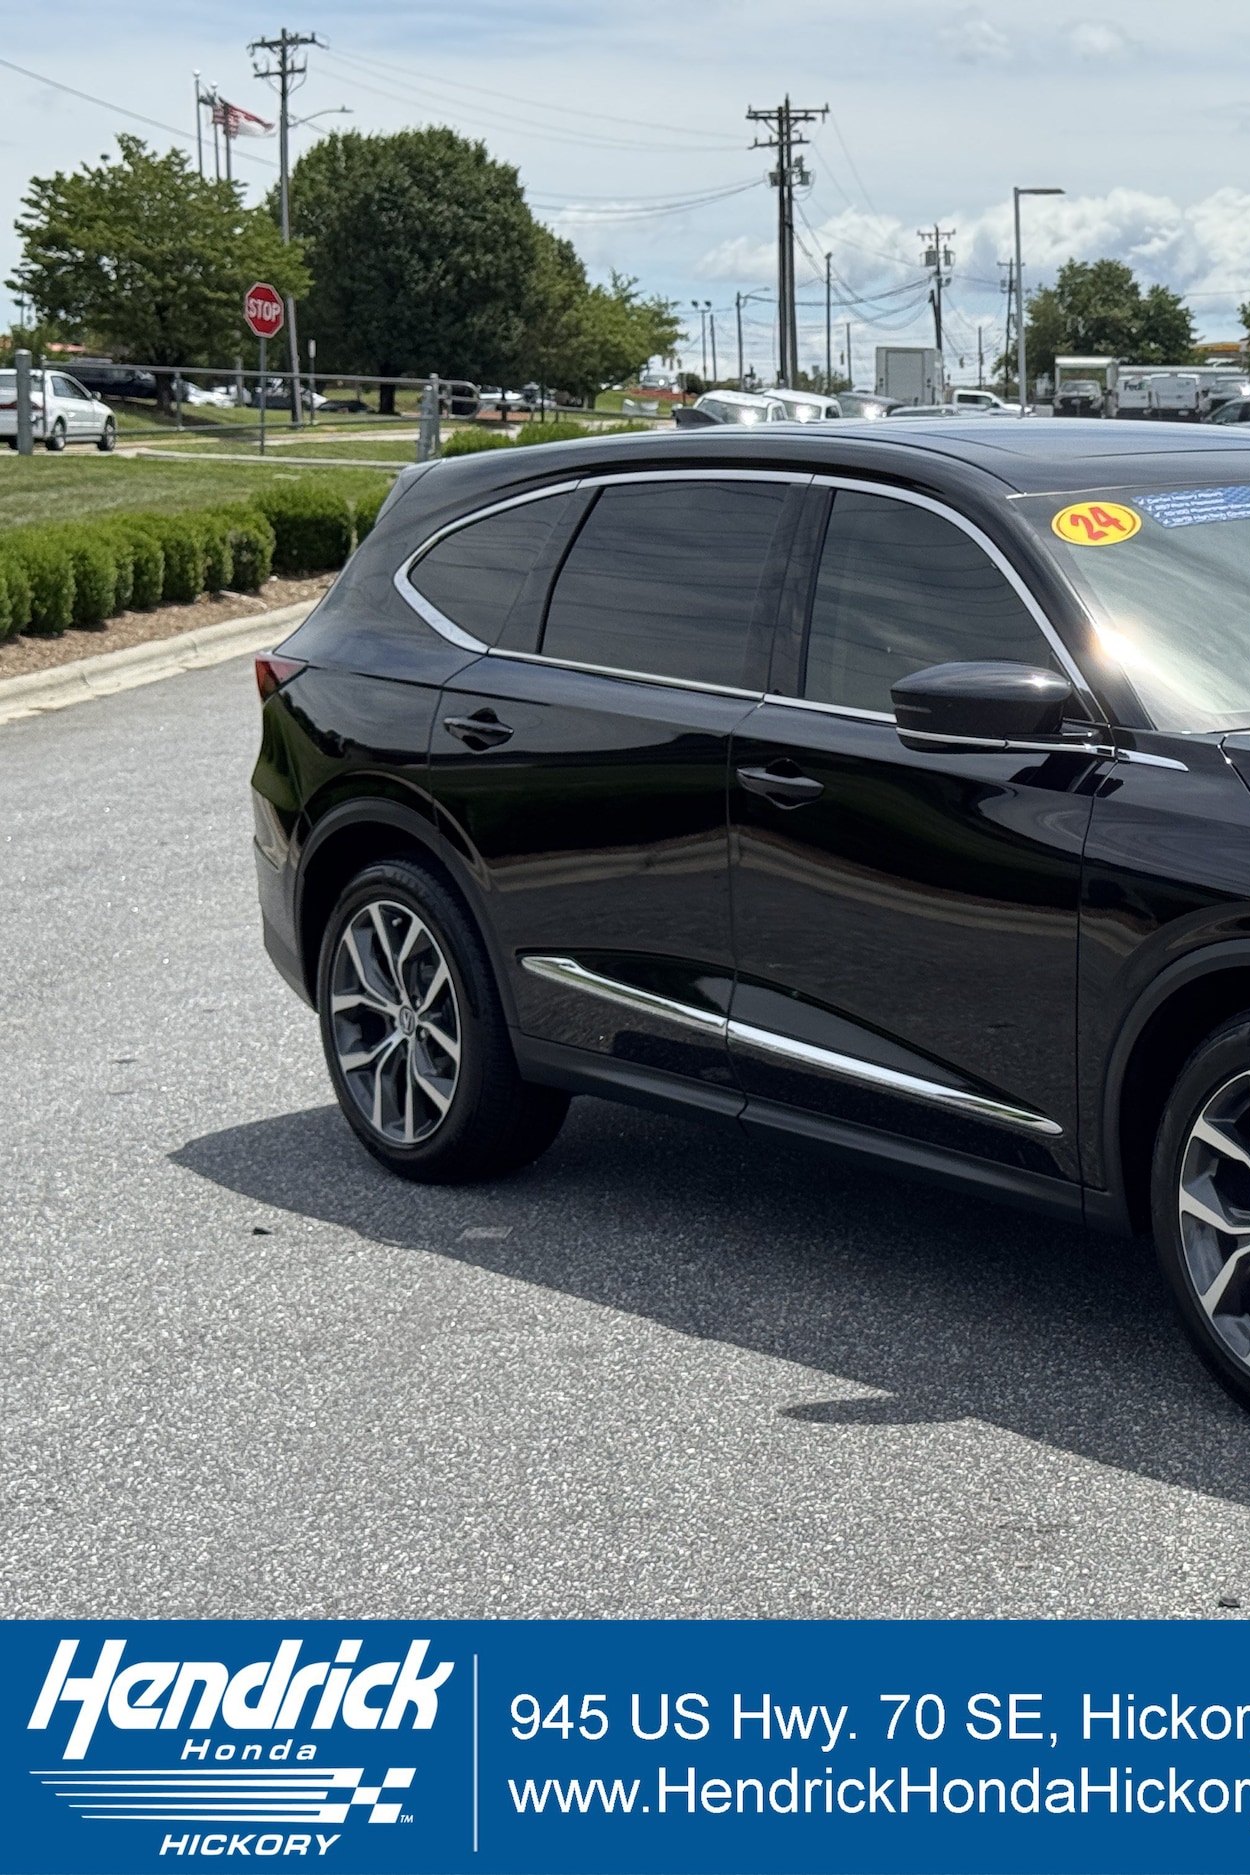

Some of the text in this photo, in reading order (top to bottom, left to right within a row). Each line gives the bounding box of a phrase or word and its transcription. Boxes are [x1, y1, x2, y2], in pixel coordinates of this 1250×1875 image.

[247, 298, 281, 322] STOP
[1124, 381, 1149, 391] FedE
[1070, 506, 1127, 541] 24
